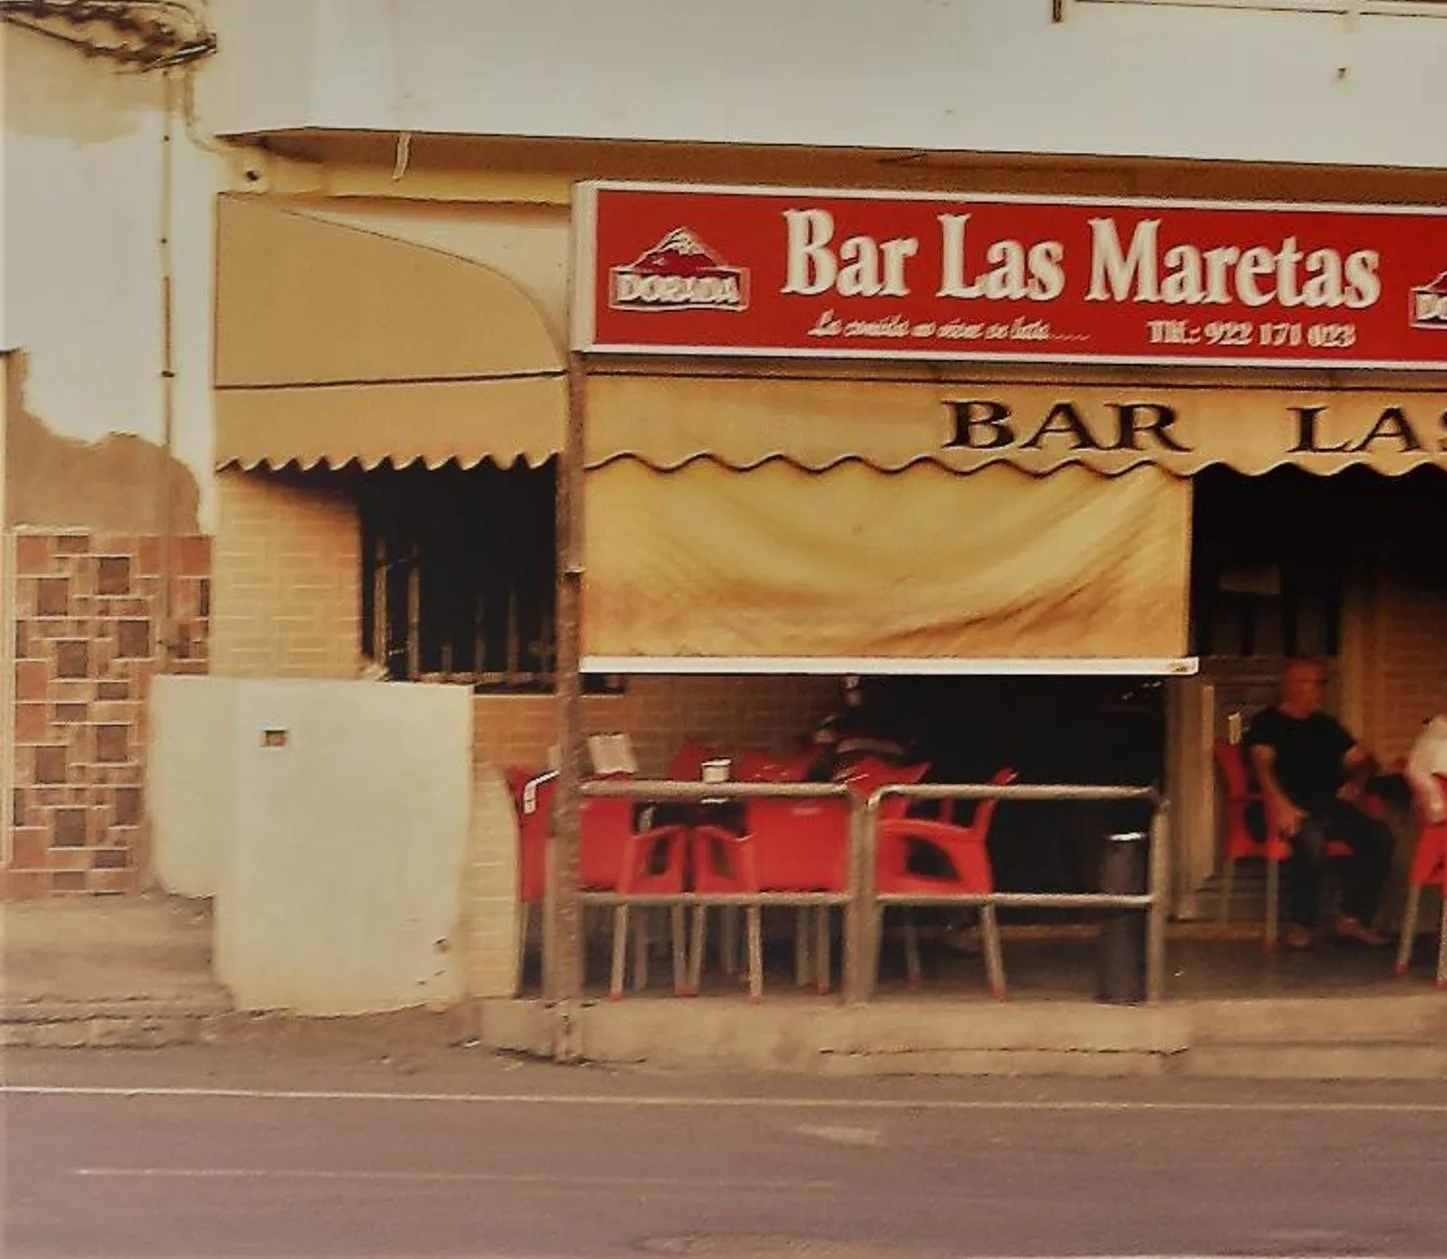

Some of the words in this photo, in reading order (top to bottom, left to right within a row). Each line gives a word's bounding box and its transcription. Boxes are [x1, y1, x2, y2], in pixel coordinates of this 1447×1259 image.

[781, 208, 918, 297] Bar
[936, 213, 1067, 301] Las
[1084, 217, 1382, 309] Maretas
[1203, 320, 1253, 346] 922
[1258, 321, 1302, 347] 171
[939, 398, 1193, 454] BAR
